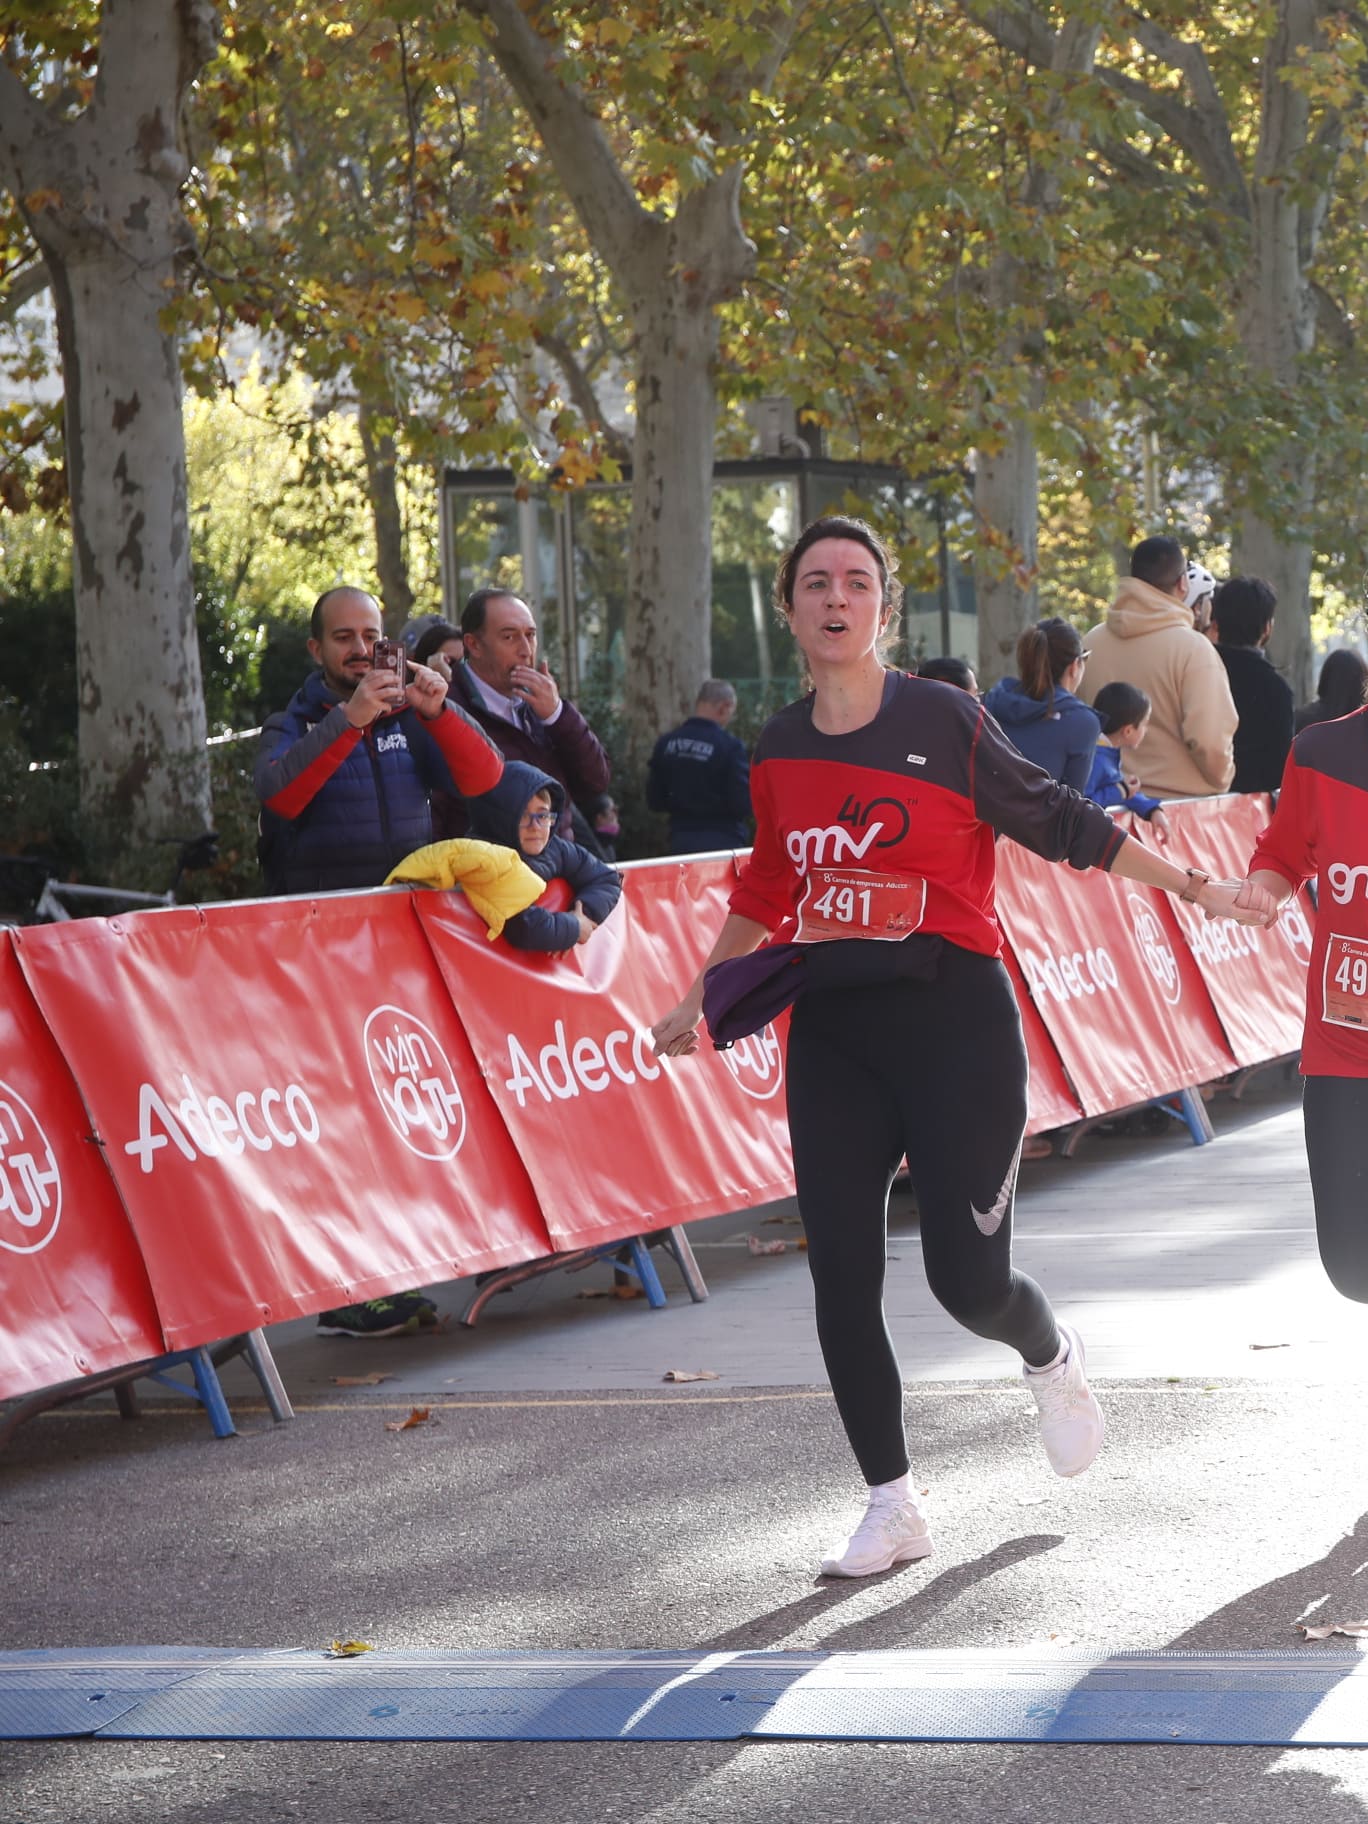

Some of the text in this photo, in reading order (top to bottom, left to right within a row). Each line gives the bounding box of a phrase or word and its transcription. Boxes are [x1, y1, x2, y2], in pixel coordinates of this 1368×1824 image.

[787, 822, 884, 877] gmv
[813, 886, 871, 927] 491
[1024, 942, 1119, 1005] Adecco
[505, 1019, 661, 1107] Adecc
[124, 1072, 321, 1174] Adecco
